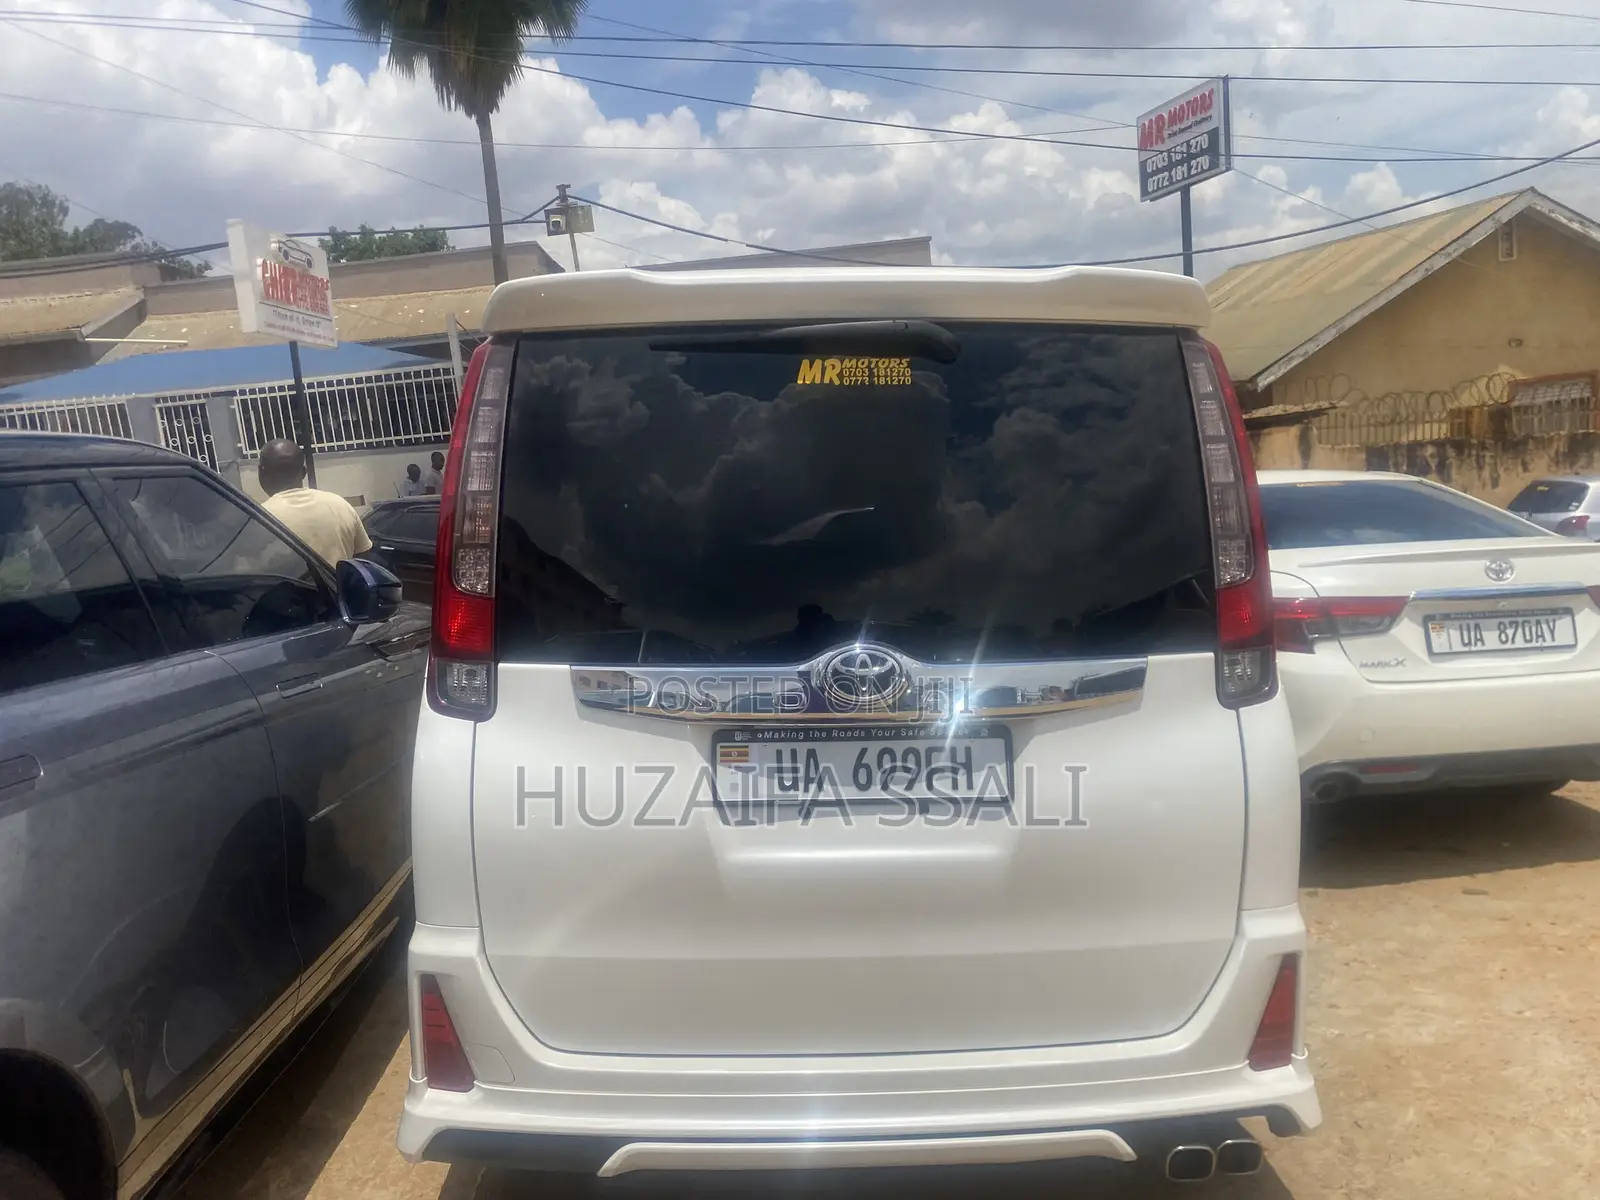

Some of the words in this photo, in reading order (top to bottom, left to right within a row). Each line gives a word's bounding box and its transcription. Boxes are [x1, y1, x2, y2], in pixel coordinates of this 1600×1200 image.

[1139, 113, 1166, 151] MR
[1168, 88, 1214, 127] MOTORS
[1147, 152, 1168, 172] 0703
[1170, 143, 1187, 162] 181
[1190, 134, 1209, 153] 270
[1147, 172, 1169, 192] 0772
[1171, 163, 1188, 182] 181
[1190, 155, 1210, 175] 270
[797, 358, 841, 385] MR
[841, 358, 911, 369] MOTORS
[843, 368, 869, 376] 0703
[873, 368, 911, 376] 181270
[843, 376, 869, 385] 0772
[873, 376, 911, 385] 181270
[1460, 622, 1485, 648] UA
[1498, 618, 1557, 645] 870AY
[763, 730, 804, 740] Making
[809, 729, 827, 738] the
[832, 729, 866, 738] Roads
[871, 728, 896, 737] Your
[901, 728, 925, 737] Safe
[776, 748, 824, 793] UA
